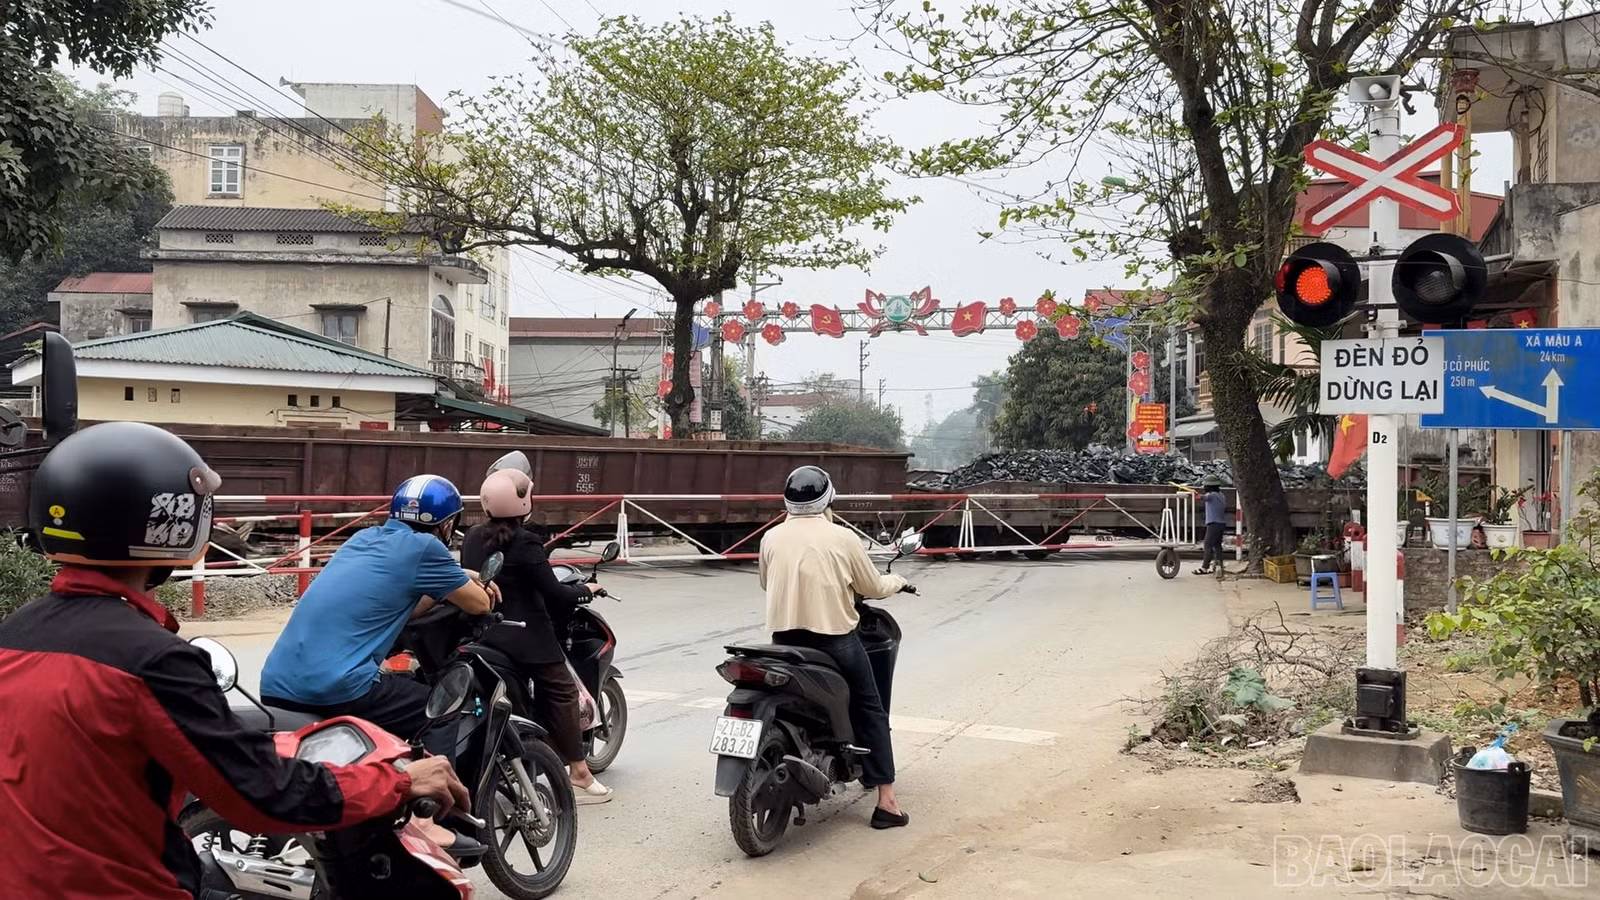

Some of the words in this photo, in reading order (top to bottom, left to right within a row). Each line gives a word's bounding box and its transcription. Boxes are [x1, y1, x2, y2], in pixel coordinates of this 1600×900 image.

[1525, 333, 1541, 347] XÃ
[1545, 334, 1570, 349] MẬU
[1574, 335, 1582, 347] A
[1334, 343, 1384, 367] ĐÈN
[1392, 338, 1429, 366] ĐỎ
[1540, 351, 1551, 362] 24
[1551, 351, 1565, 362] km
[1464, 357, 1490, 371] PHÚC
[1327, 376, 1393, 400] DỪNG
[1401, 380, 1438, 401] LẠI
[1450, 376, 1466, 387] 250
[1467, 378, 1475, 387] m
[578, 473, 590, 482] 38
[721, 720, 754, 738] 21-B2
[713, 736, 754, 755] 283.28
